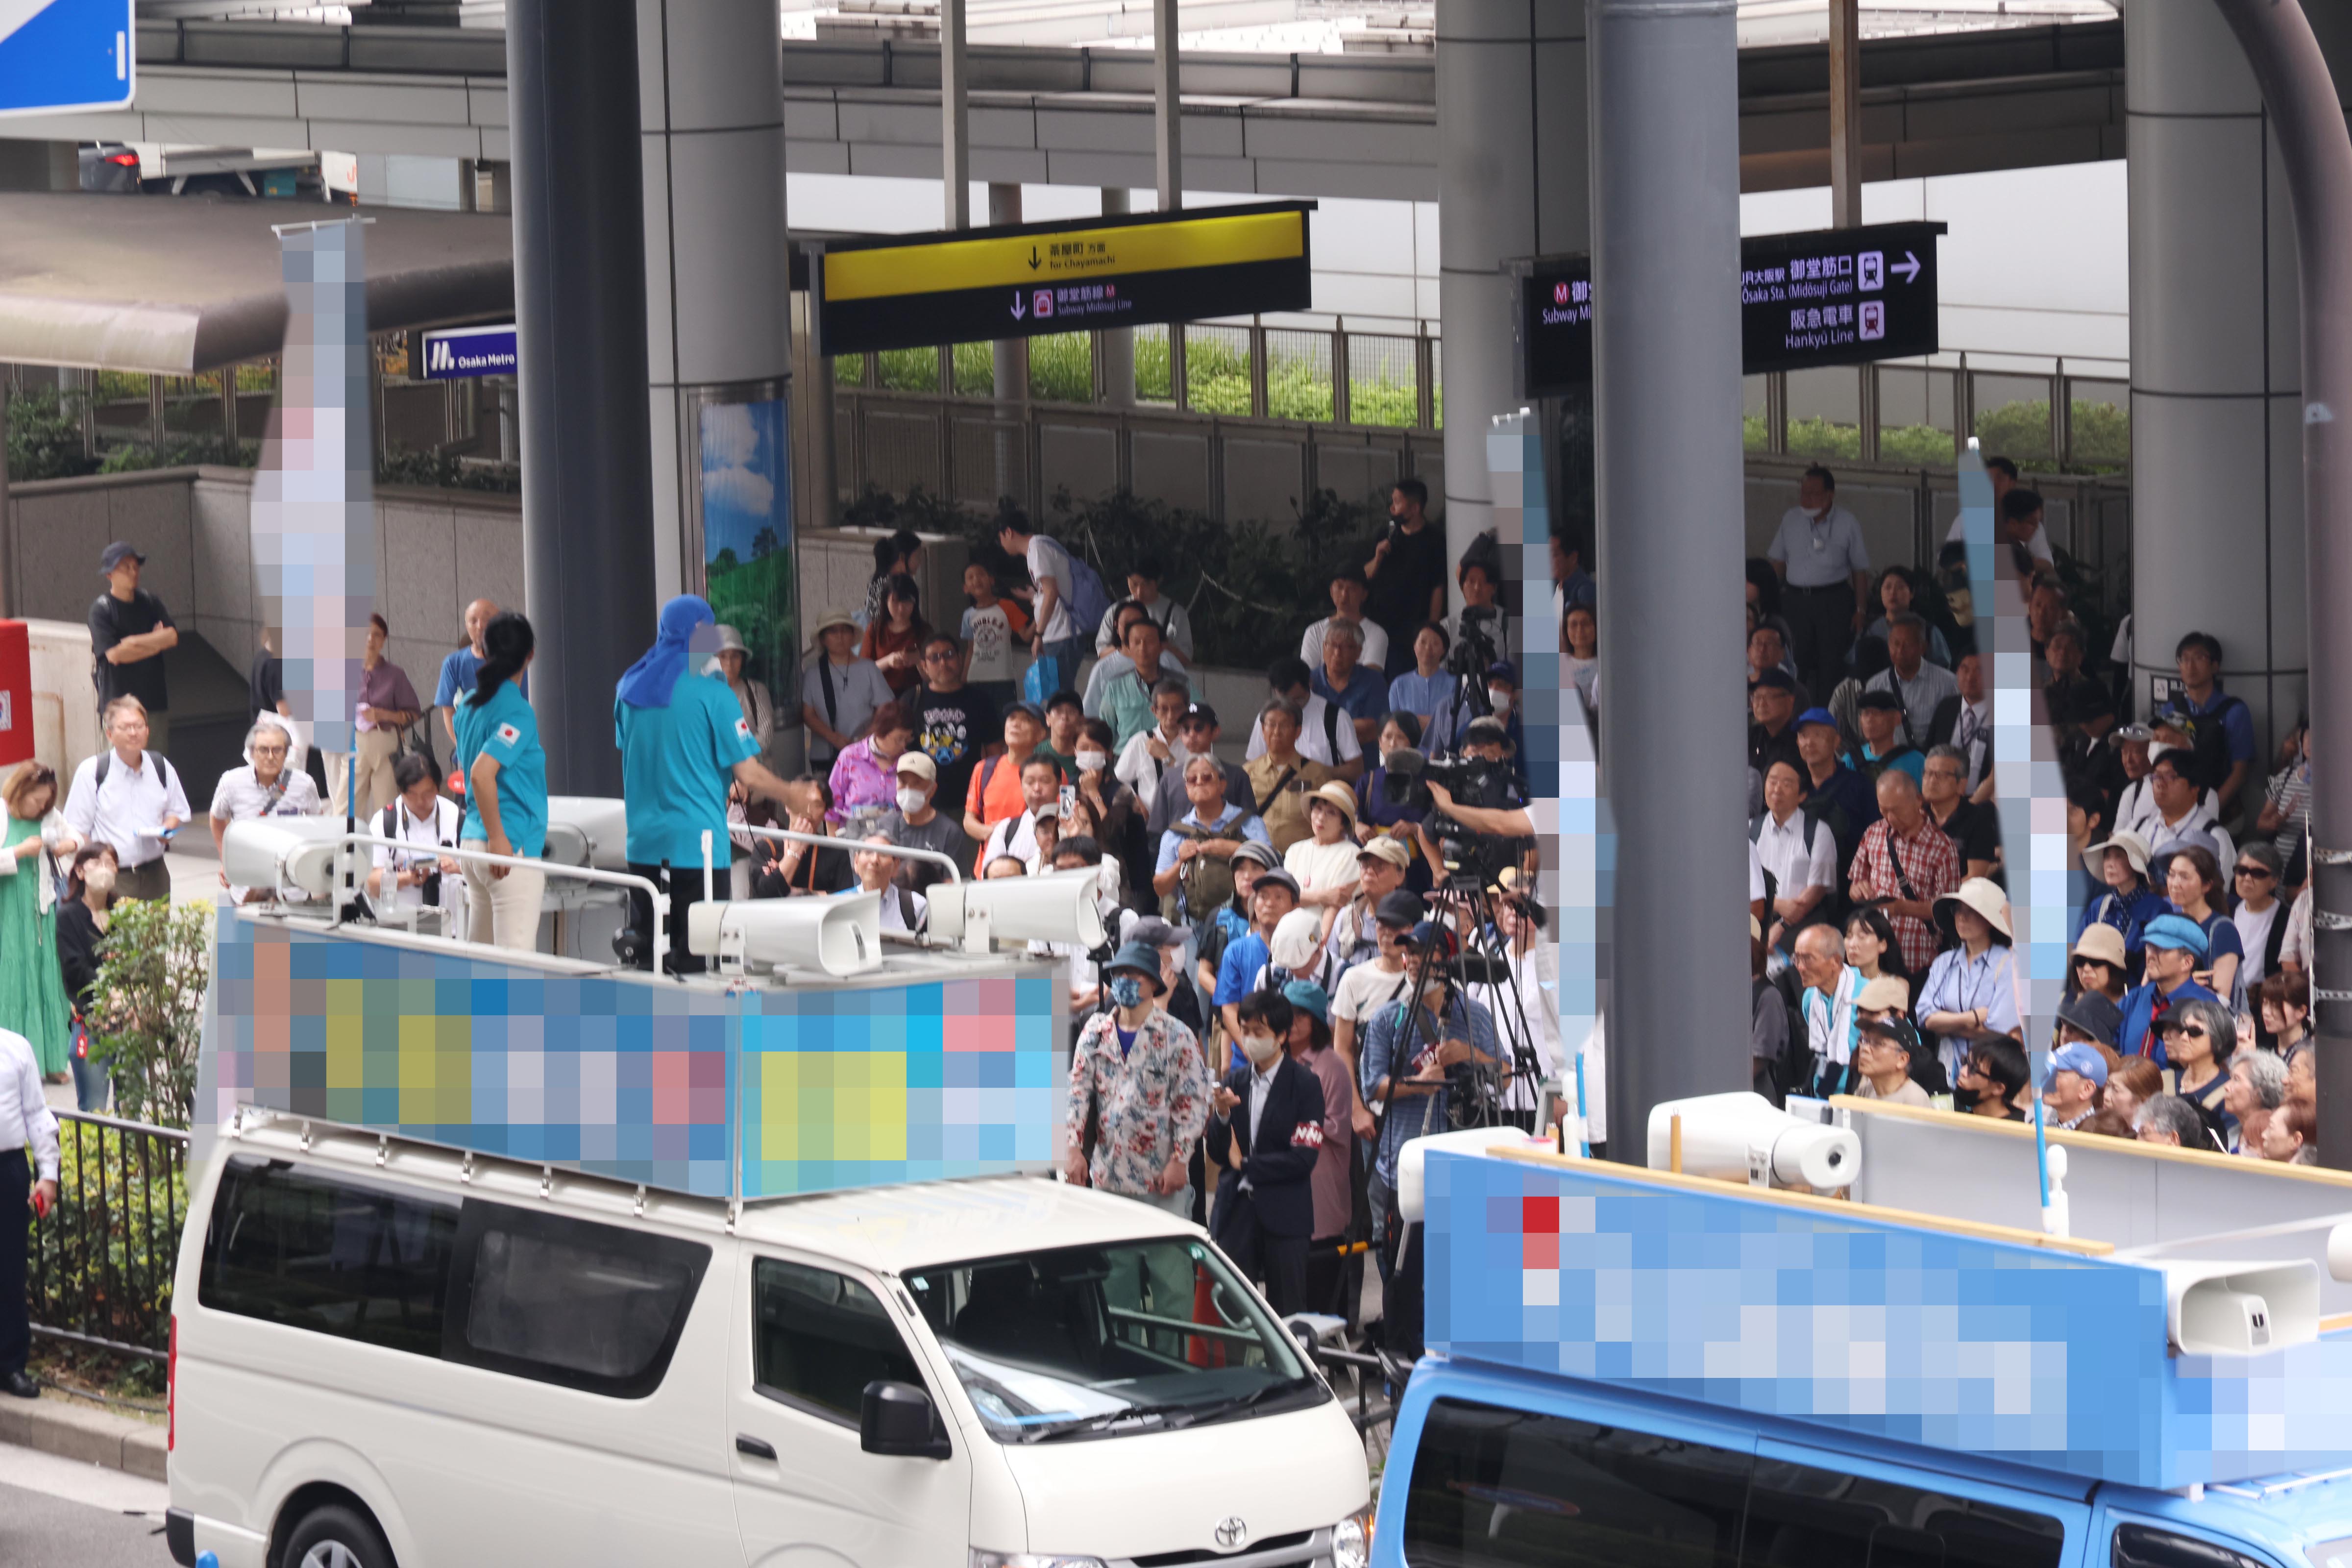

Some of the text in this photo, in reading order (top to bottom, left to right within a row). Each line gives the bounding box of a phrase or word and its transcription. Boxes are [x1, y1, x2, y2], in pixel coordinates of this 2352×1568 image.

[1064, 255, 1115, 269] Chayamachi
[1741, 255, 1852, 286] JR大阪駅 御堂筋口
[1057, 284, 1103, 303] 御堂筋線
[1571, 280, 1592, 303] 御
[1770, 286, 1787, 301] Sta.
[1830, 278, 1853, 295] Gate)
[1058, 303, 1084, 317] Subway
[1118, 298, 1132, 310] Line
[1543, 306, 1578, 326] Subway
[1790, 304, 1853, 331] 阪急電車
[1831, 328, 1854, 344] Line
[458, 354, 487, 369] Osaka
[488, 353, 515, 367] Metro
